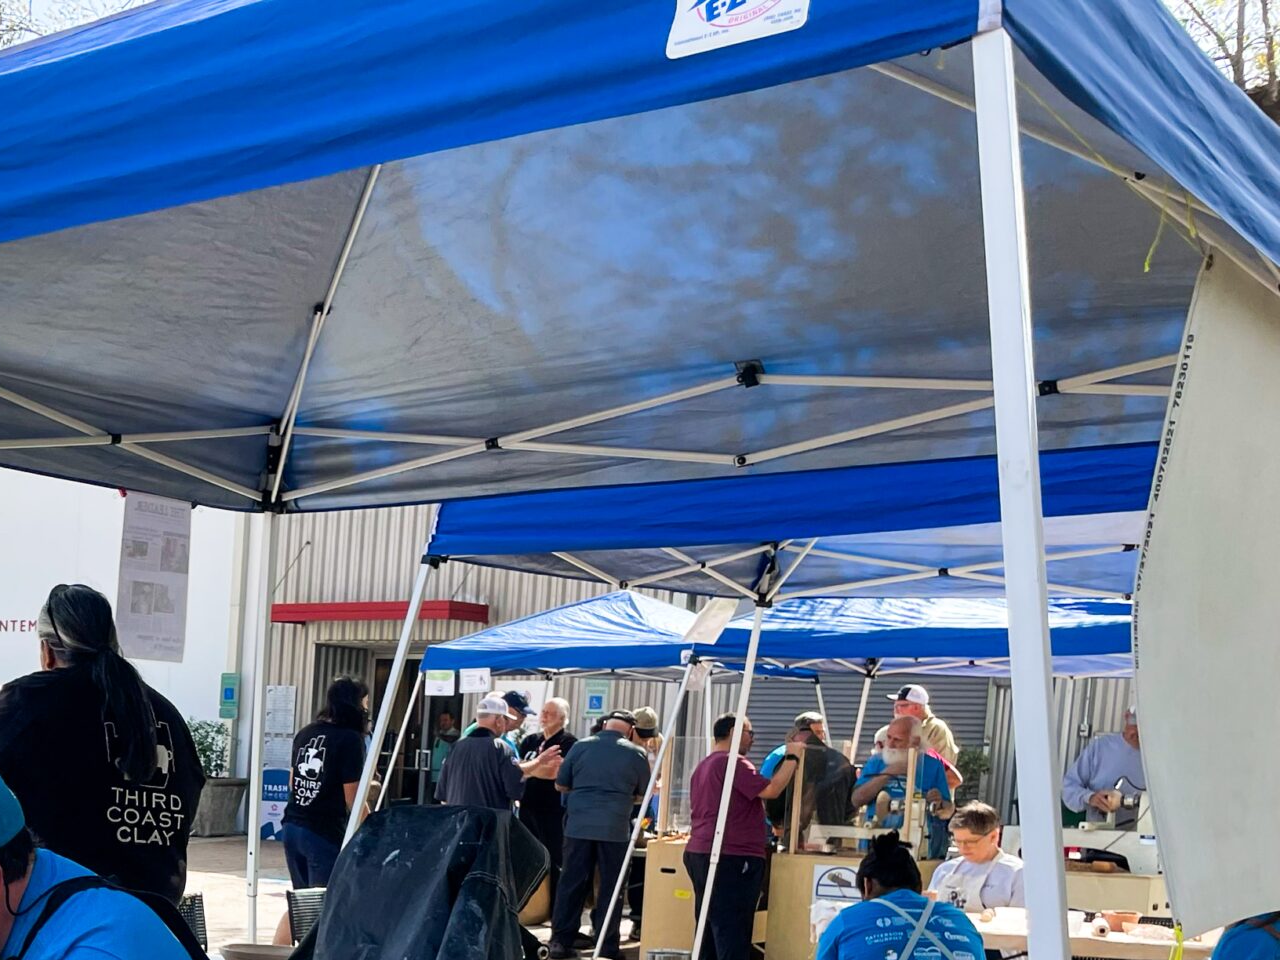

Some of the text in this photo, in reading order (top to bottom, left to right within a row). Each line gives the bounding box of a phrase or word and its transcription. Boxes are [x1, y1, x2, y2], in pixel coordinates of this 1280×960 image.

[111, 786, 182, 811] THIRD
[263, 784, 289, 792] TRASH
[106, 806, 185, 830] COAST
[116, 825, 175, 846] CLAY
